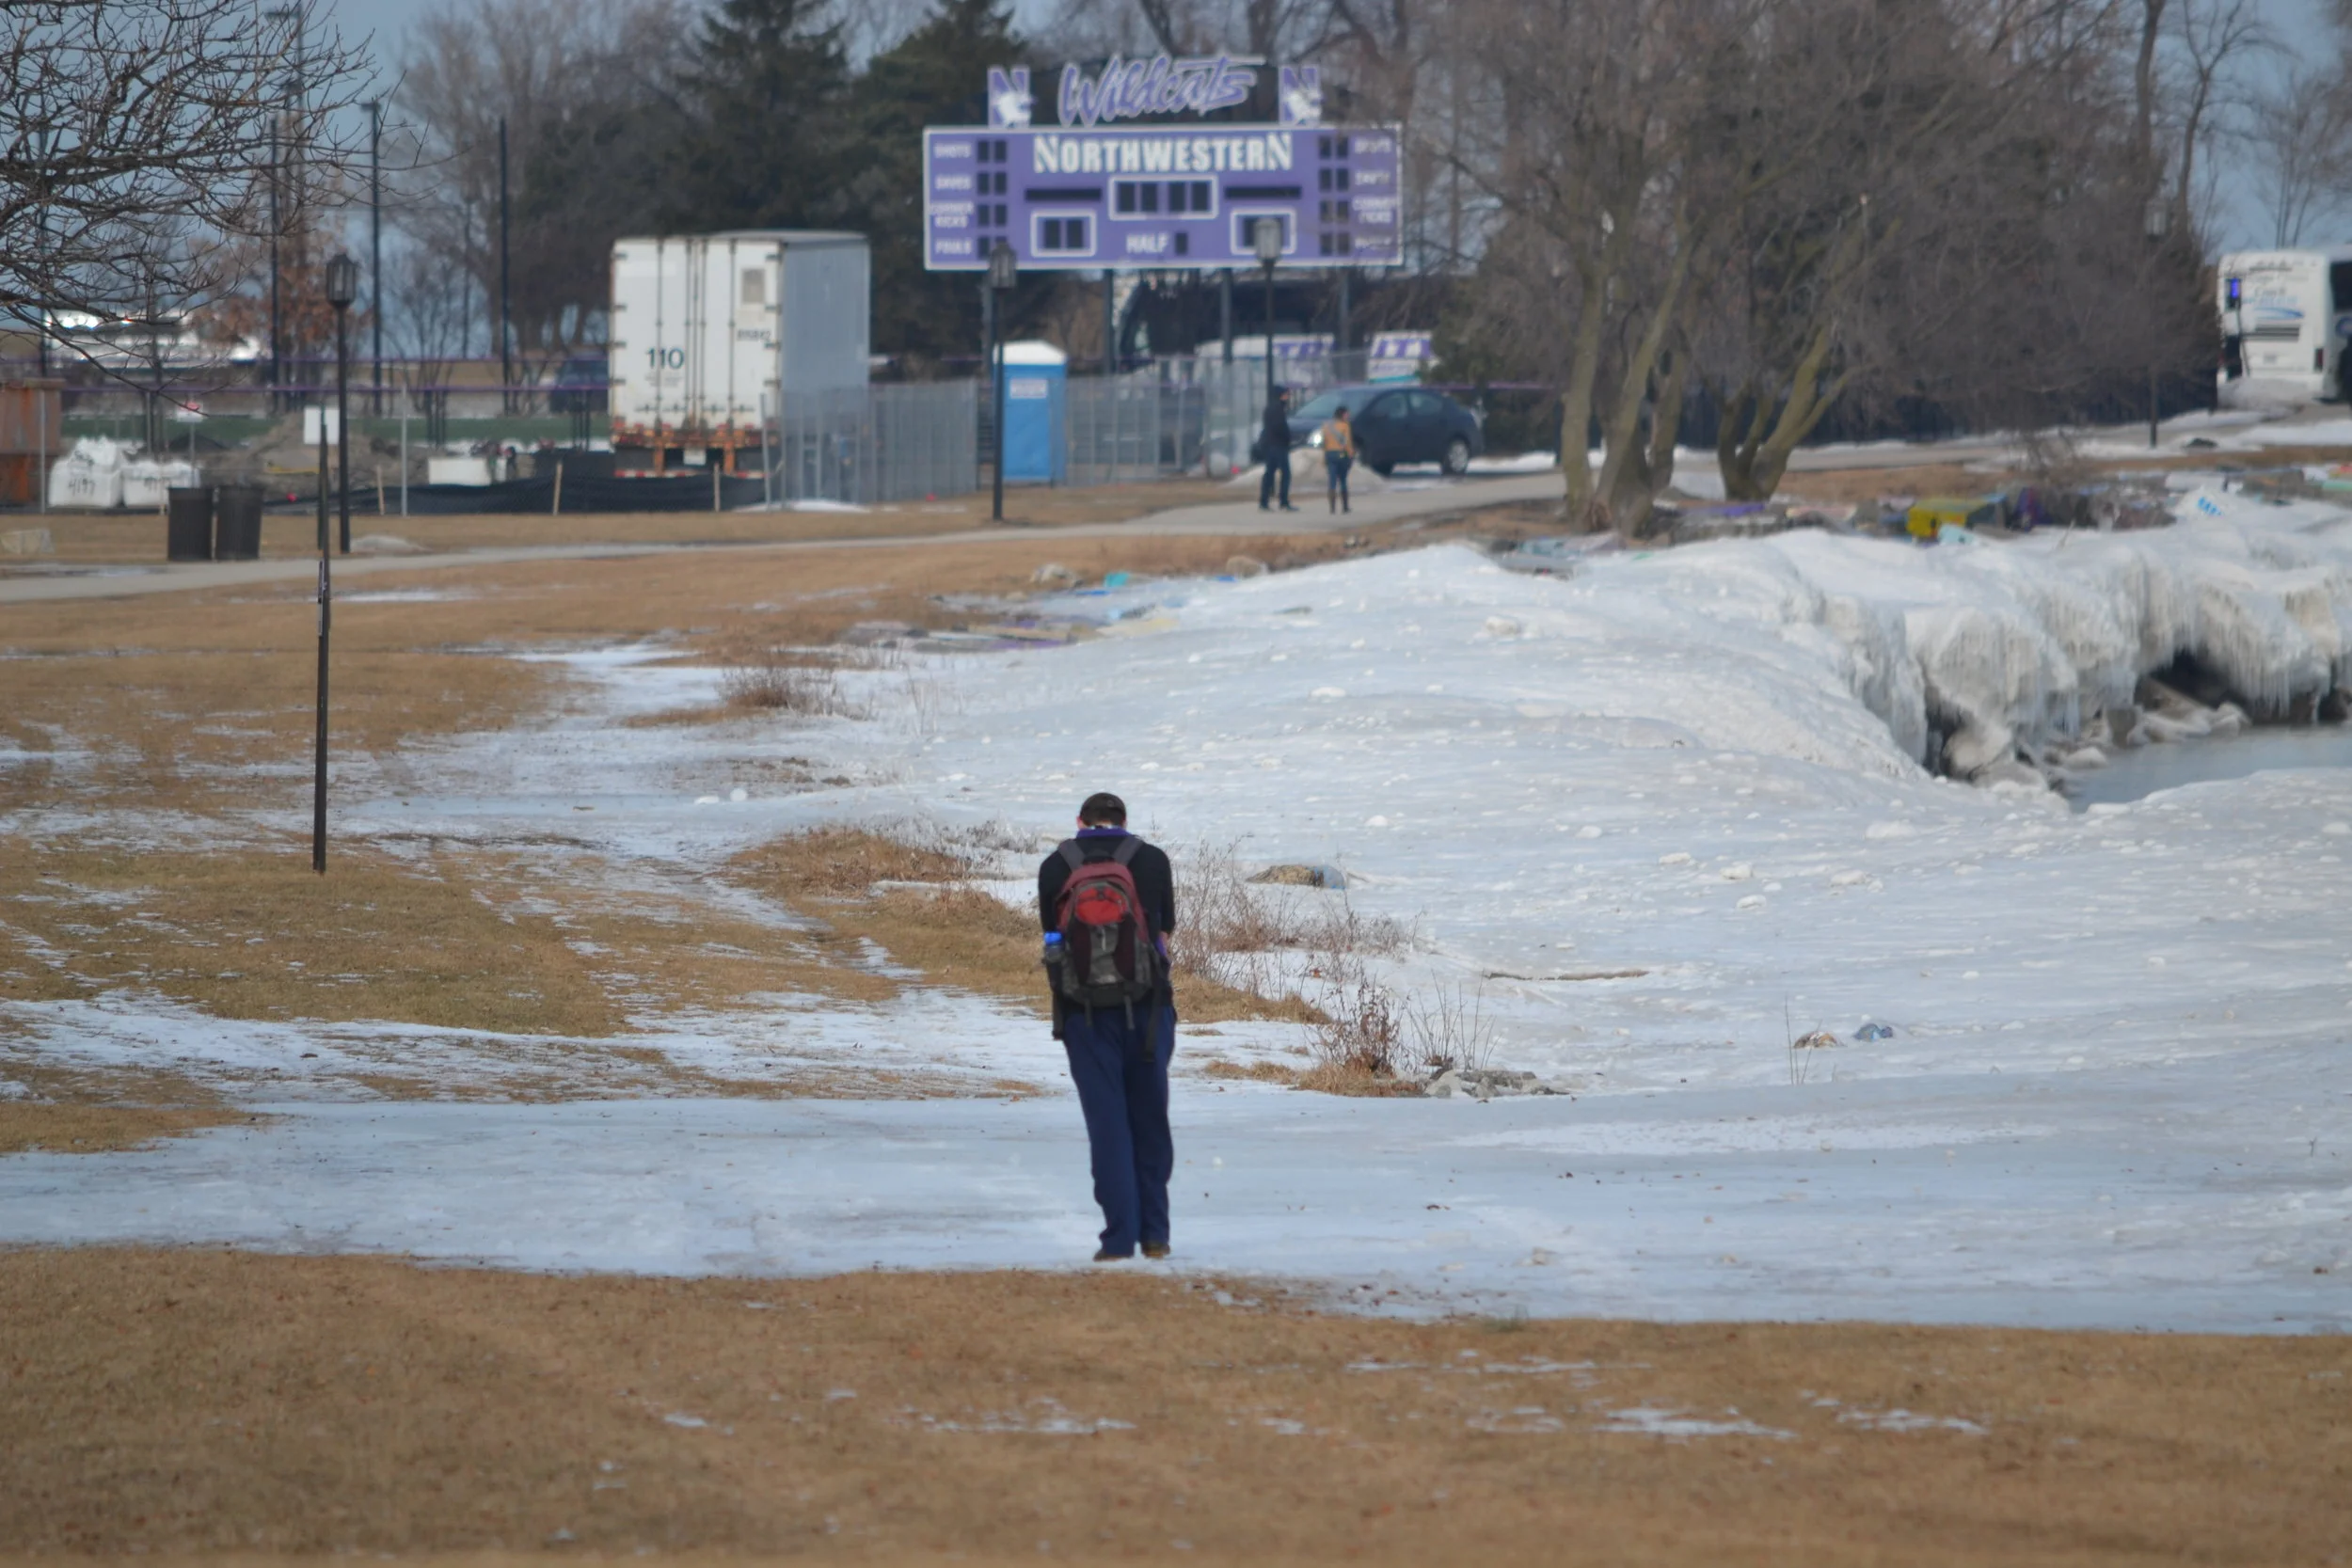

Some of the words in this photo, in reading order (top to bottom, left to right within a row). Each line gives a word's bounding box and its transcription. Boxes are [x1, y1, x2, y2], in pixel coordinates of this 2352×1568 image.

[1057, 51, 1266, 129] Wildcats
[1034, 132, 1293, 174] NORTHWESTERN
[1126, 232, 1168, 254] HALF
[645, 347, 686, 370] 110
